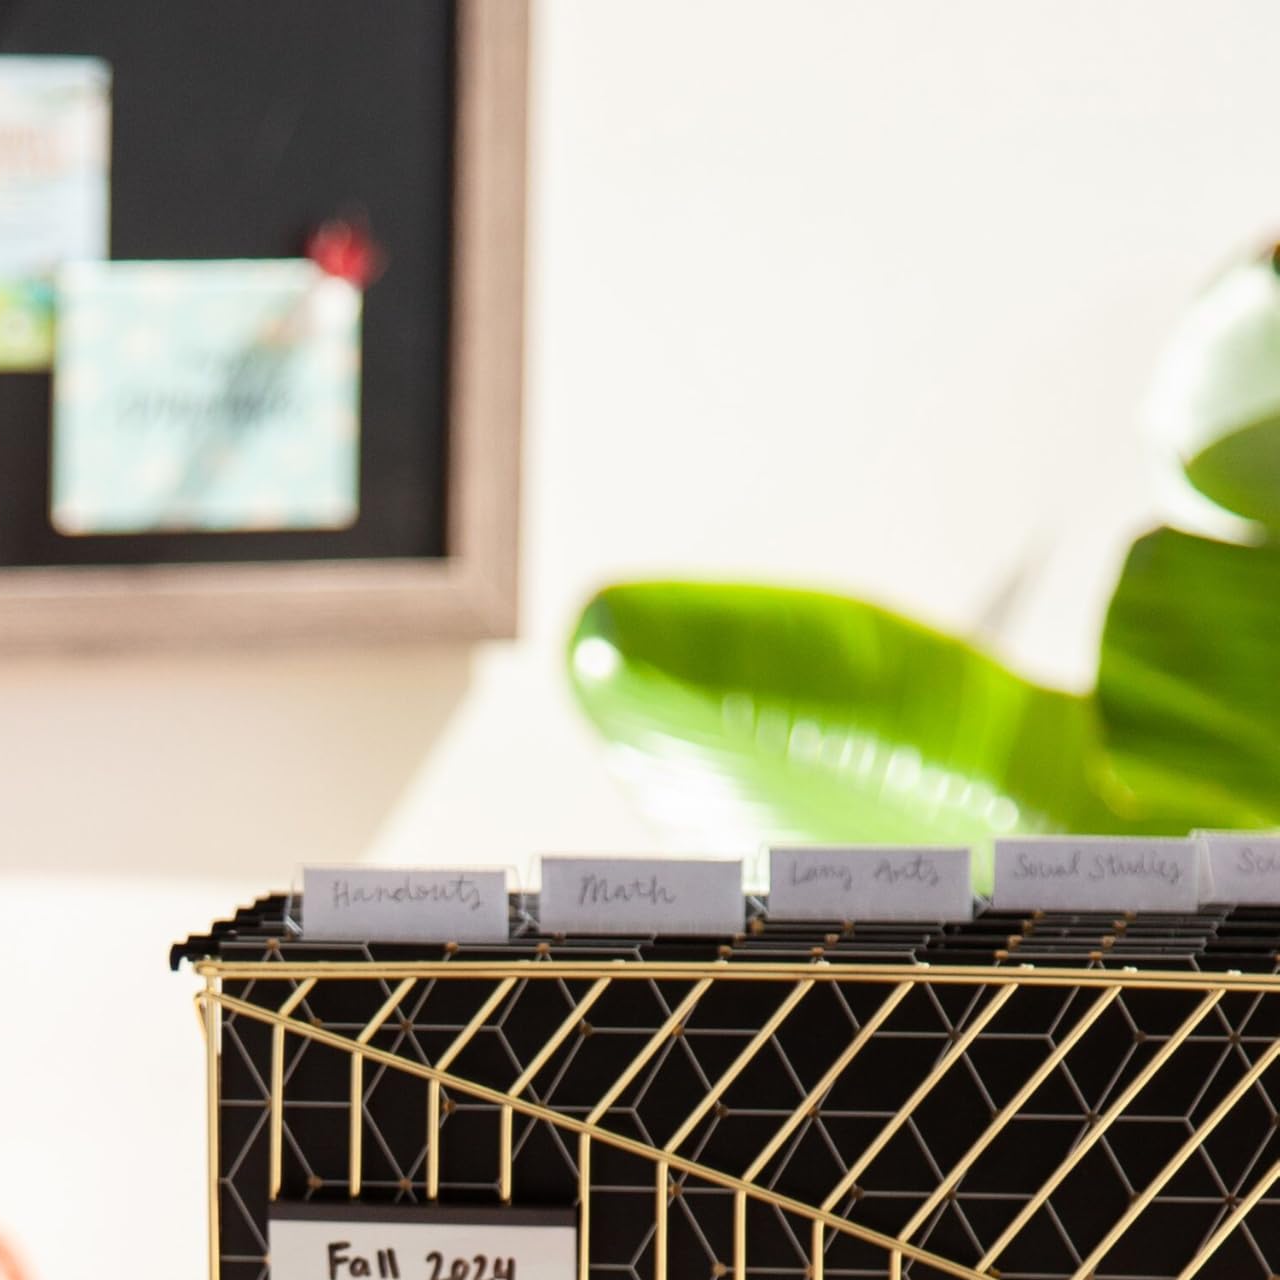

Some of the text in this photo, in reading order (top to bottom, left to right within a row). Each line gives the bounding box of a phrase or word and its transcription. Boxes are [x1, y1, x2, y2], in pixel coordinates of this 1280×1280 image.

[332, 877, 482, 911] Handouts
[579, 874, 677, 907] Math
[327, 1241, 401, 1280] Fall
